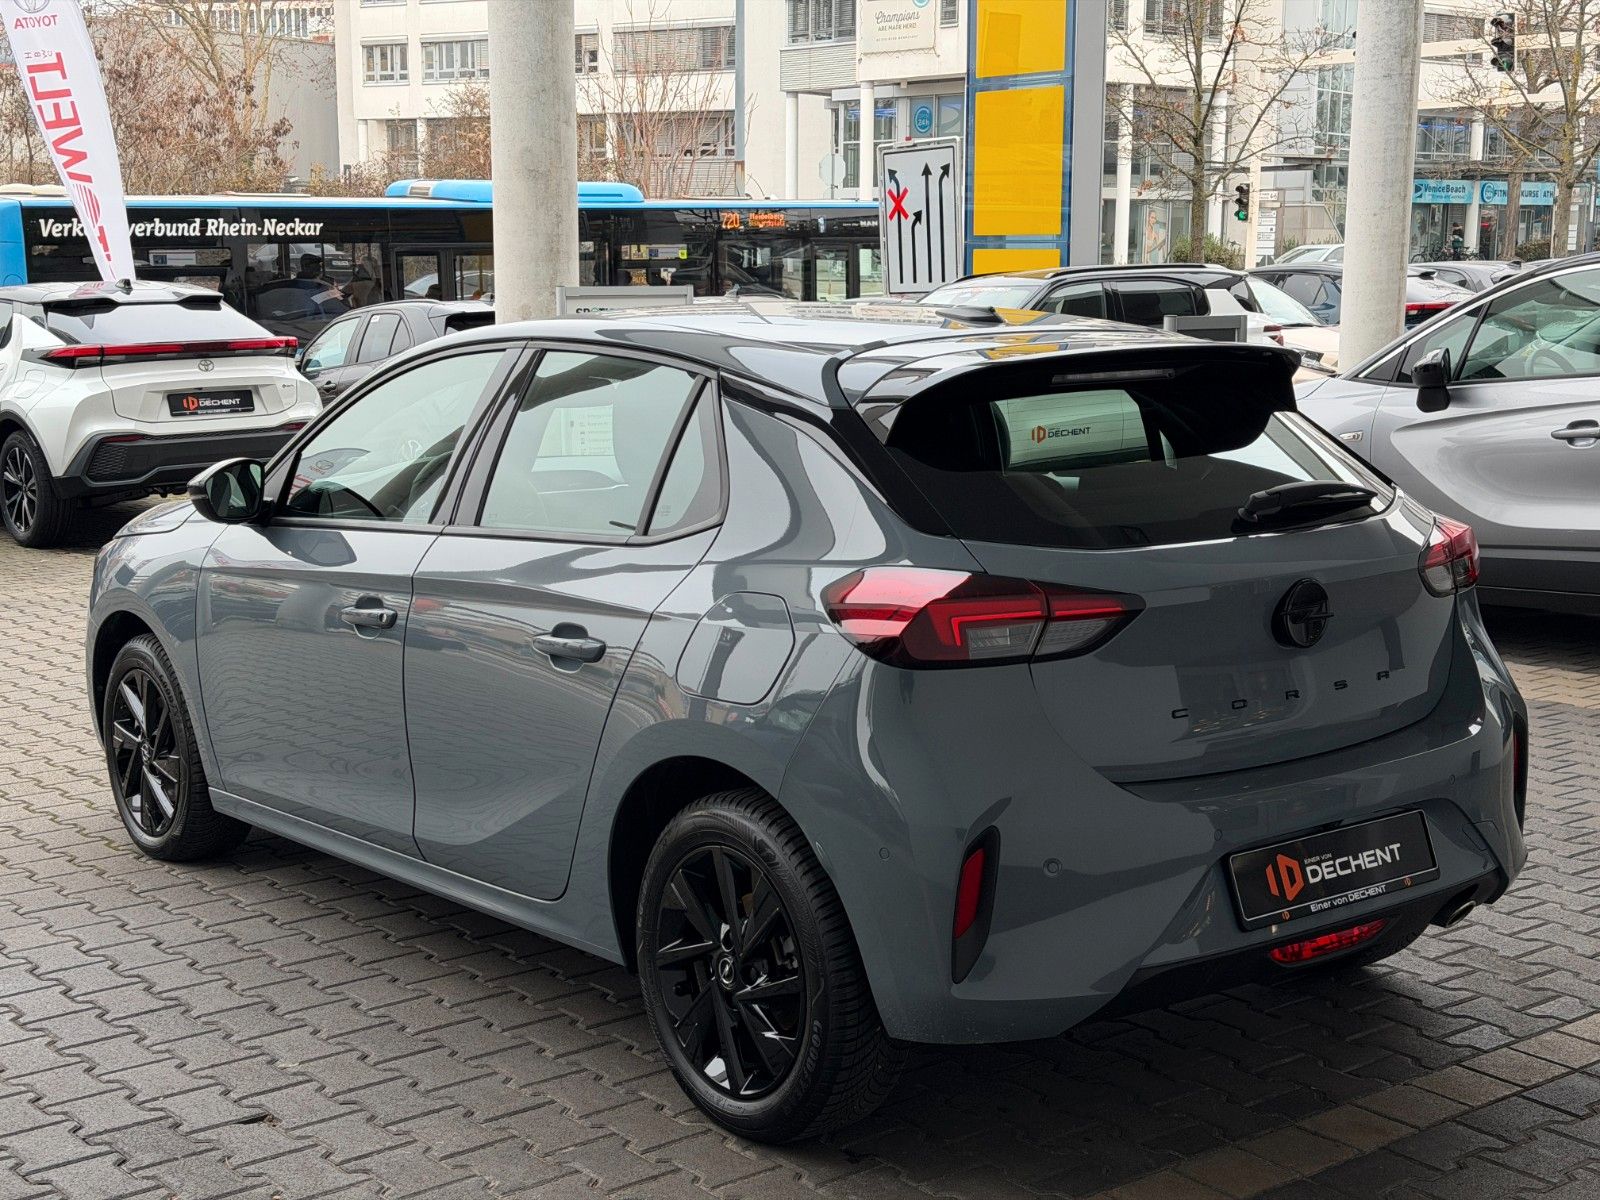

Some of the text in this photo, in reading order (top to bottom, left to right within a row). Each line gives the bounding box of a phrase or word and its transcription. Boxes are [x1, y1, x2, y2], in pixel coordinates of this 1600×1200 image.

[875, 10, 921, 25] Champions
[878, 24, 888, 32] ARE
[1424, 184, 1466, 194] VeniceBeach
[1494, 189, 1507, 198] FITN
[1521, 190, 1540, 198] KURSE
[1543, 190, 1554, 198] ATH
[720, 212, 740, 229] 720
[860, 220, 878, 228] MAN
[39, 218, 200, 237] Verkverbund
[199, 398, 241, 407] DECHENT
[1048, 427, 1091, 439] DECHENT
[1171, 669, 1390, 720] CORSA
[1304, 856, 1320, 864] EINER
[1306, 843, 1401, 884] DECHENT
[1310, 885, 1387, 912] Einer von DECHENT
